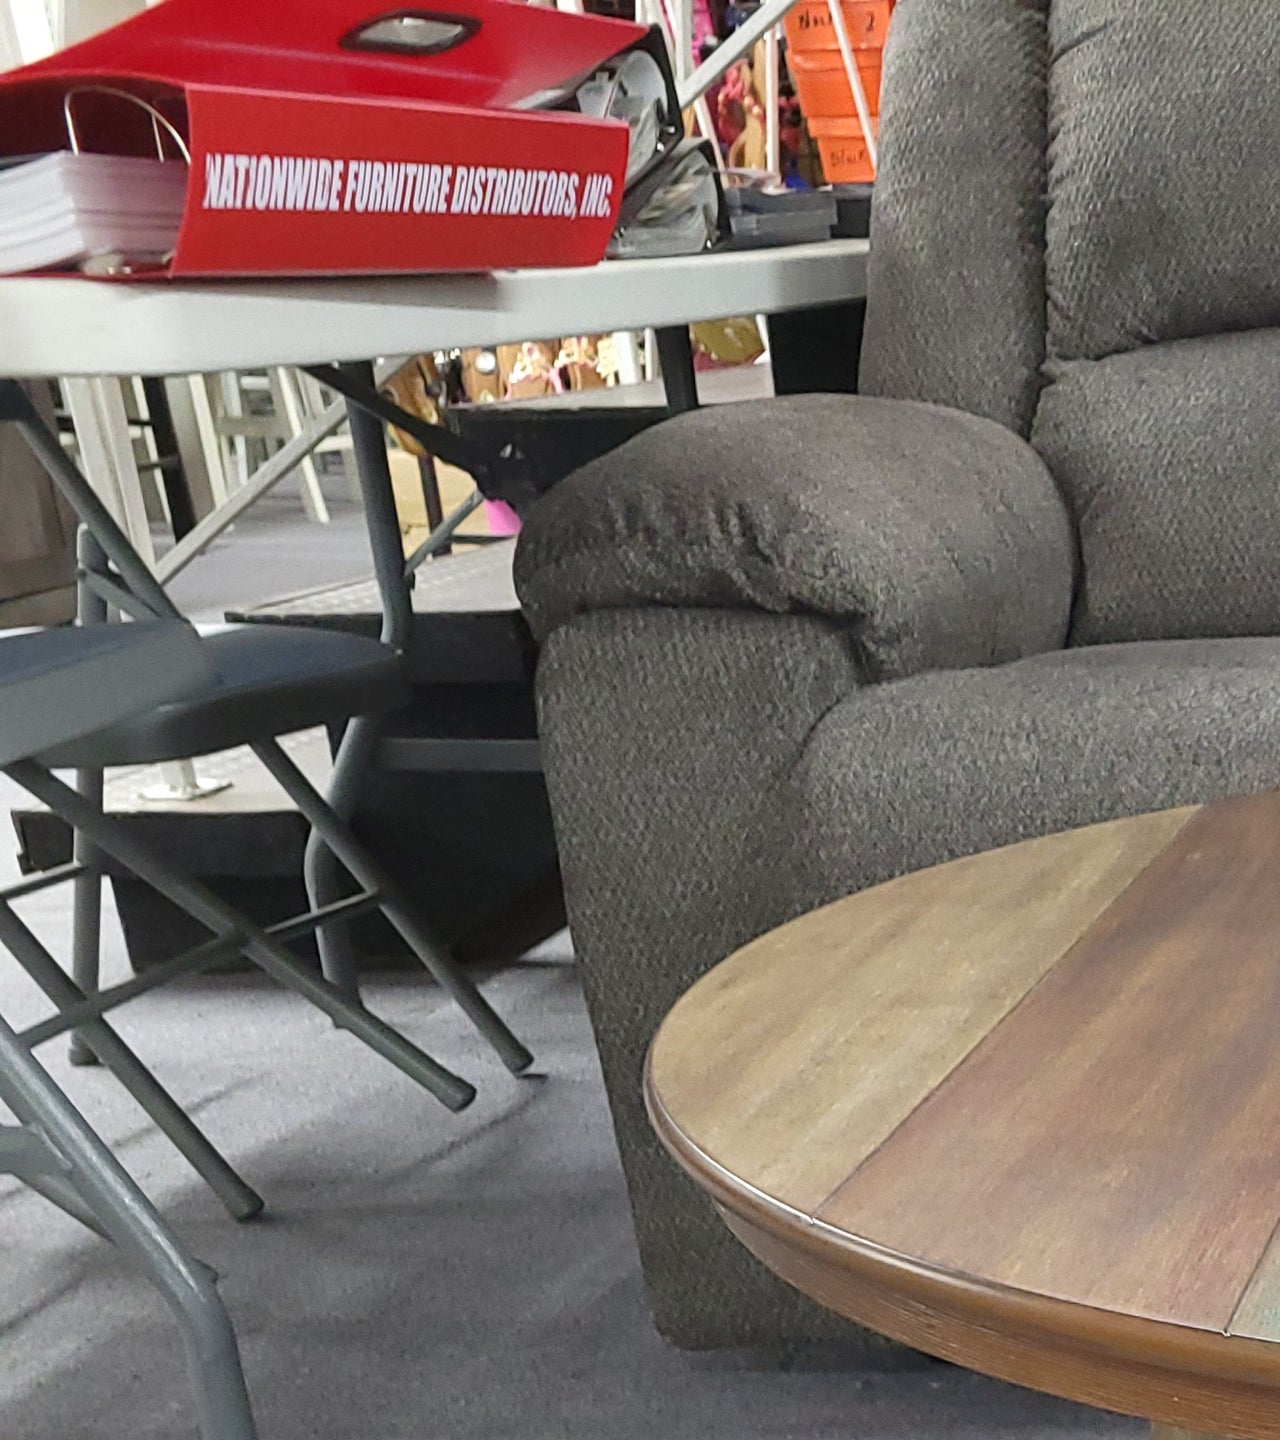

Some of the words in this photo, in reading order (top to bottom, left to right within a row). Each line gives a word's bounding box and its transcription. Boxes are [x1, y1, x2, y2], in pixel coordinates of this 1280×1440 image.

[203, 151, 344, 212] NATIONWIDE
[343, 159, 453, 214] FURNITURE
[450, 164, 580, 221] DISTRIBUTORS,
[579, 172, 613, 218] INC.
